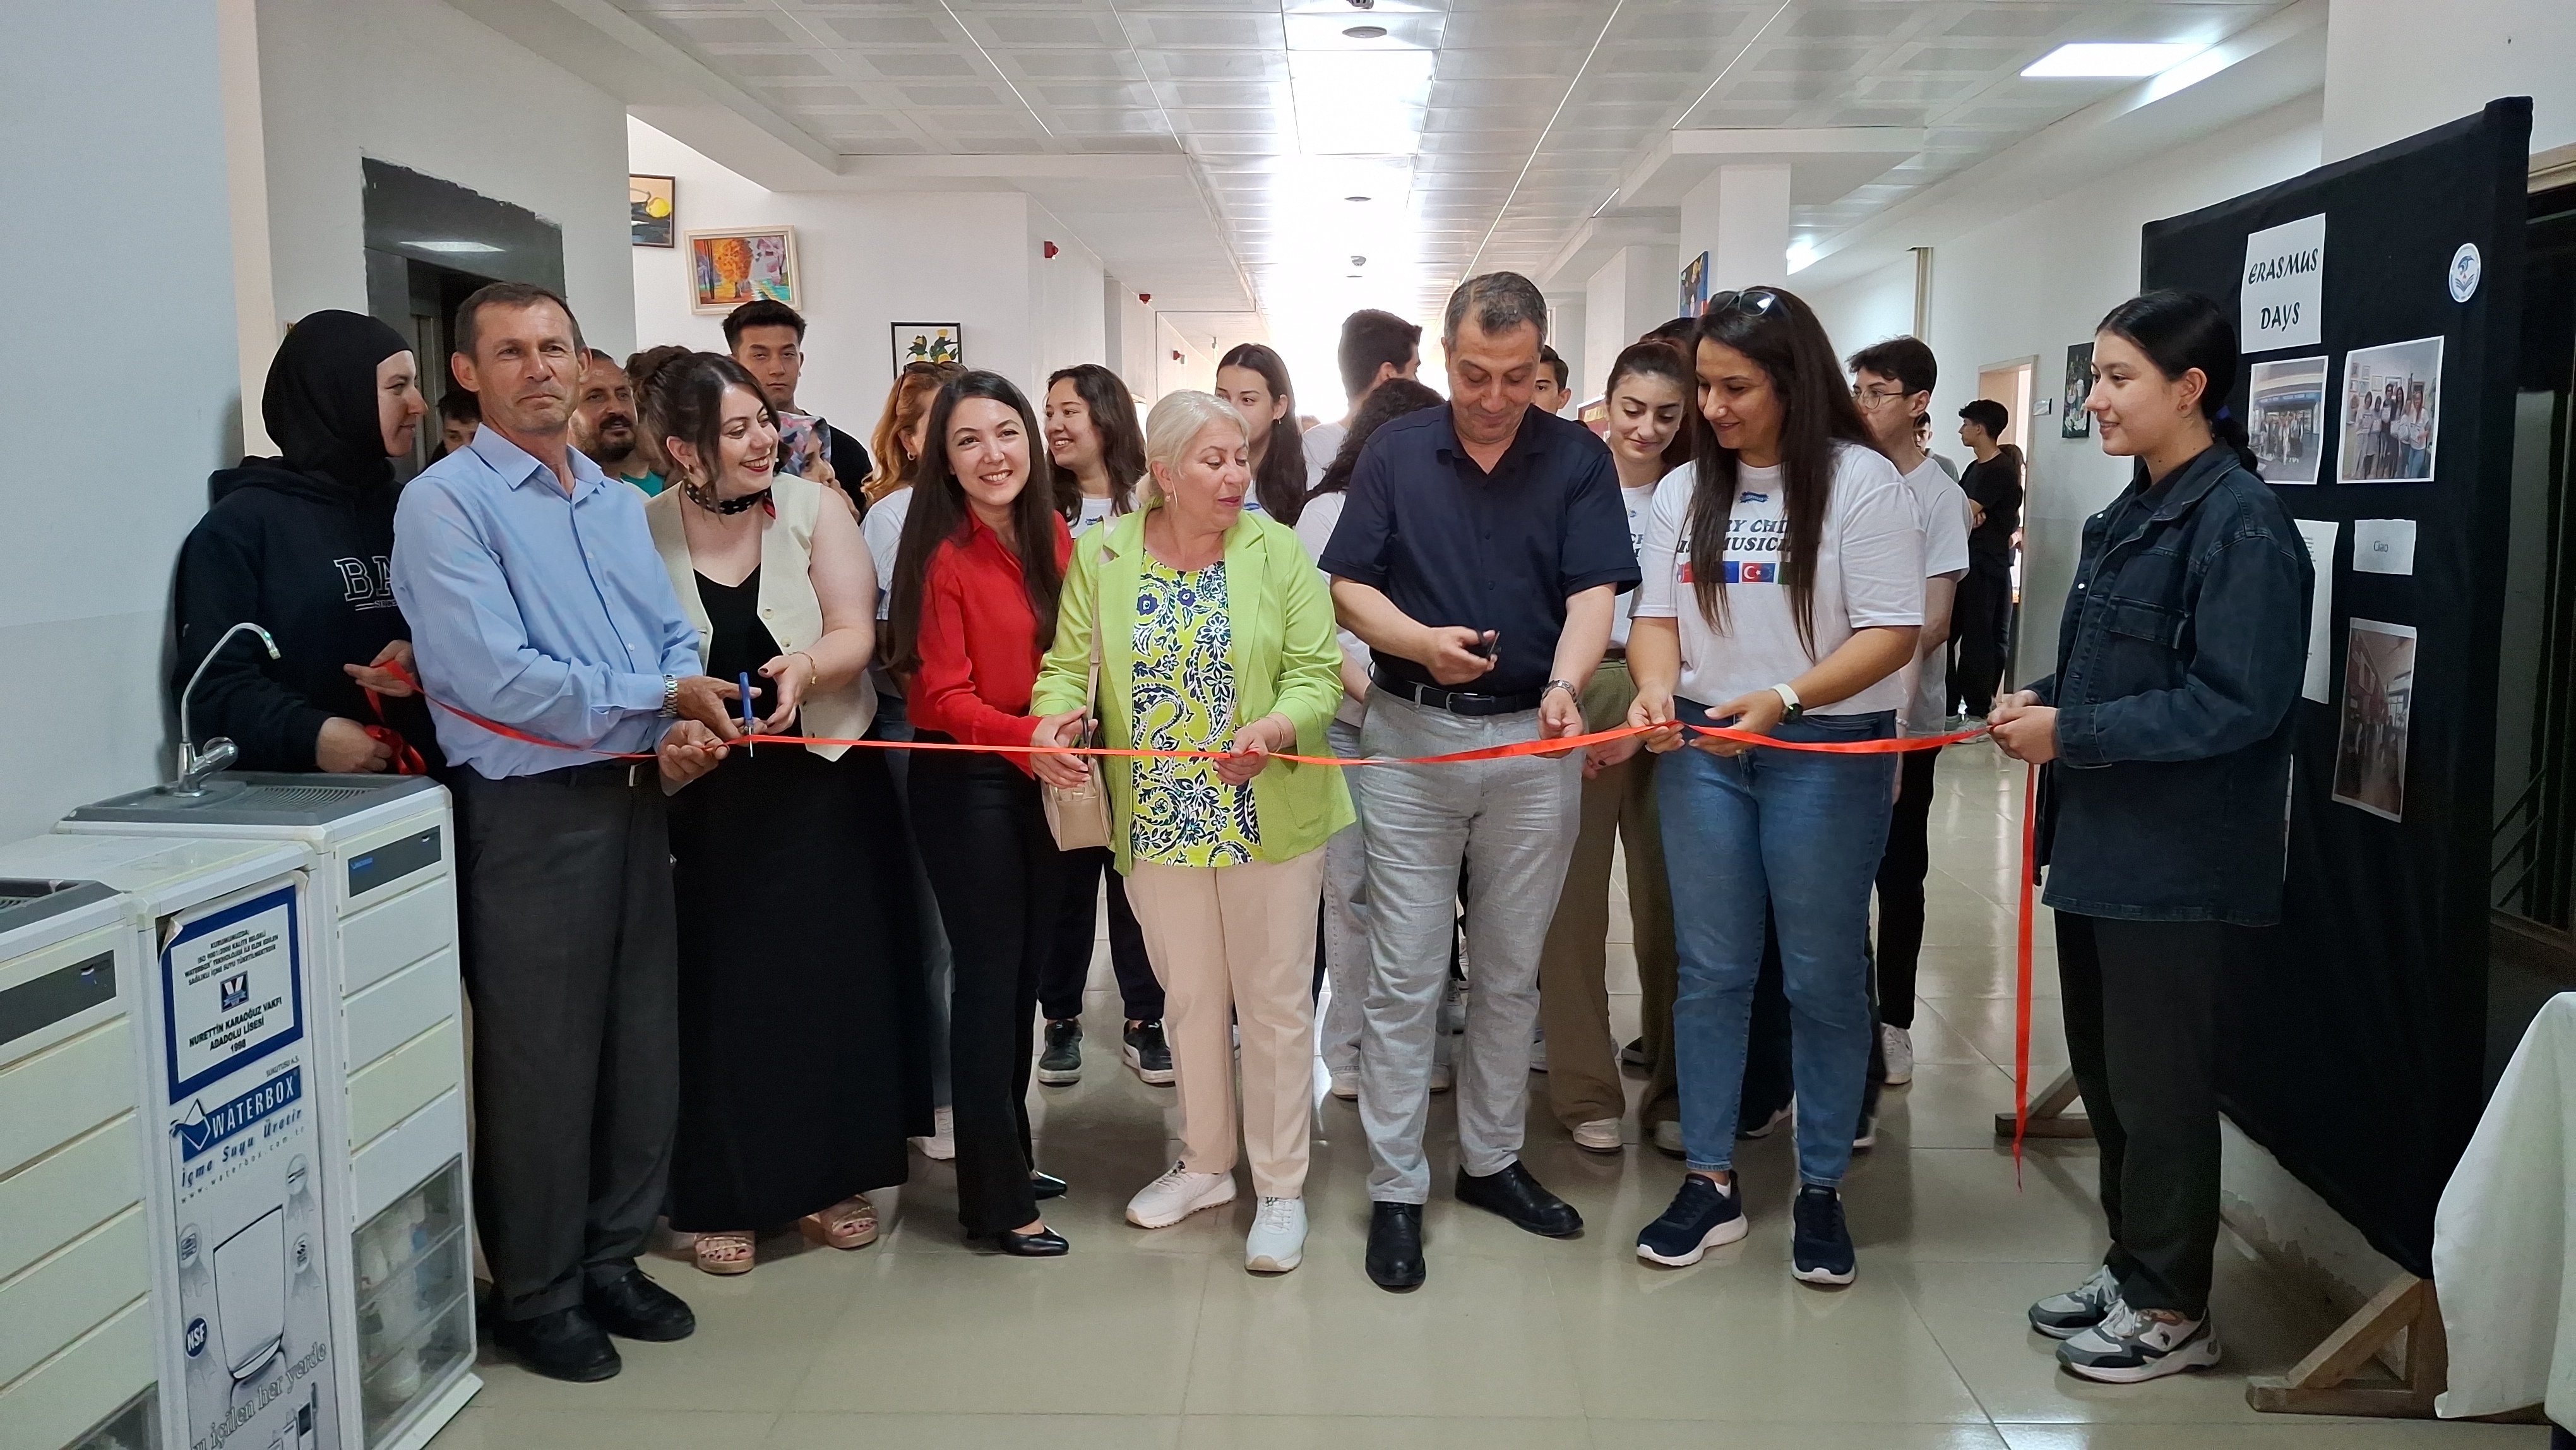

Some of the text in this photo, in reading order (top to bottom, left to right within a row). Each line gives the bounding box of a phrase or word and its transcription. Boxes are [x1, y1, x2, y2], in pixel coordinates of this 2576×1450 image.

[2248, 248, 2318, 285] ERASMUS
[2260, 302, 2300, 332] DAYS
[1750, 519, 1787, 534] CHI
[2373, 540, 2388, 553] Ciao
[189, 1023, 224, 1047] NURETTİN
[263, 996, 282, 1011] VAKFI
[212, 1076, 294, 1139] WATERBOX
[222, 1137, 254, 1163] Suyu
[263, 1109, 302, 1138] Üretir
[187, 1322, 205, 1352] NSF
[258, 1375, 284, 1411] her
[285, 1341, 326, 1394] yerde
